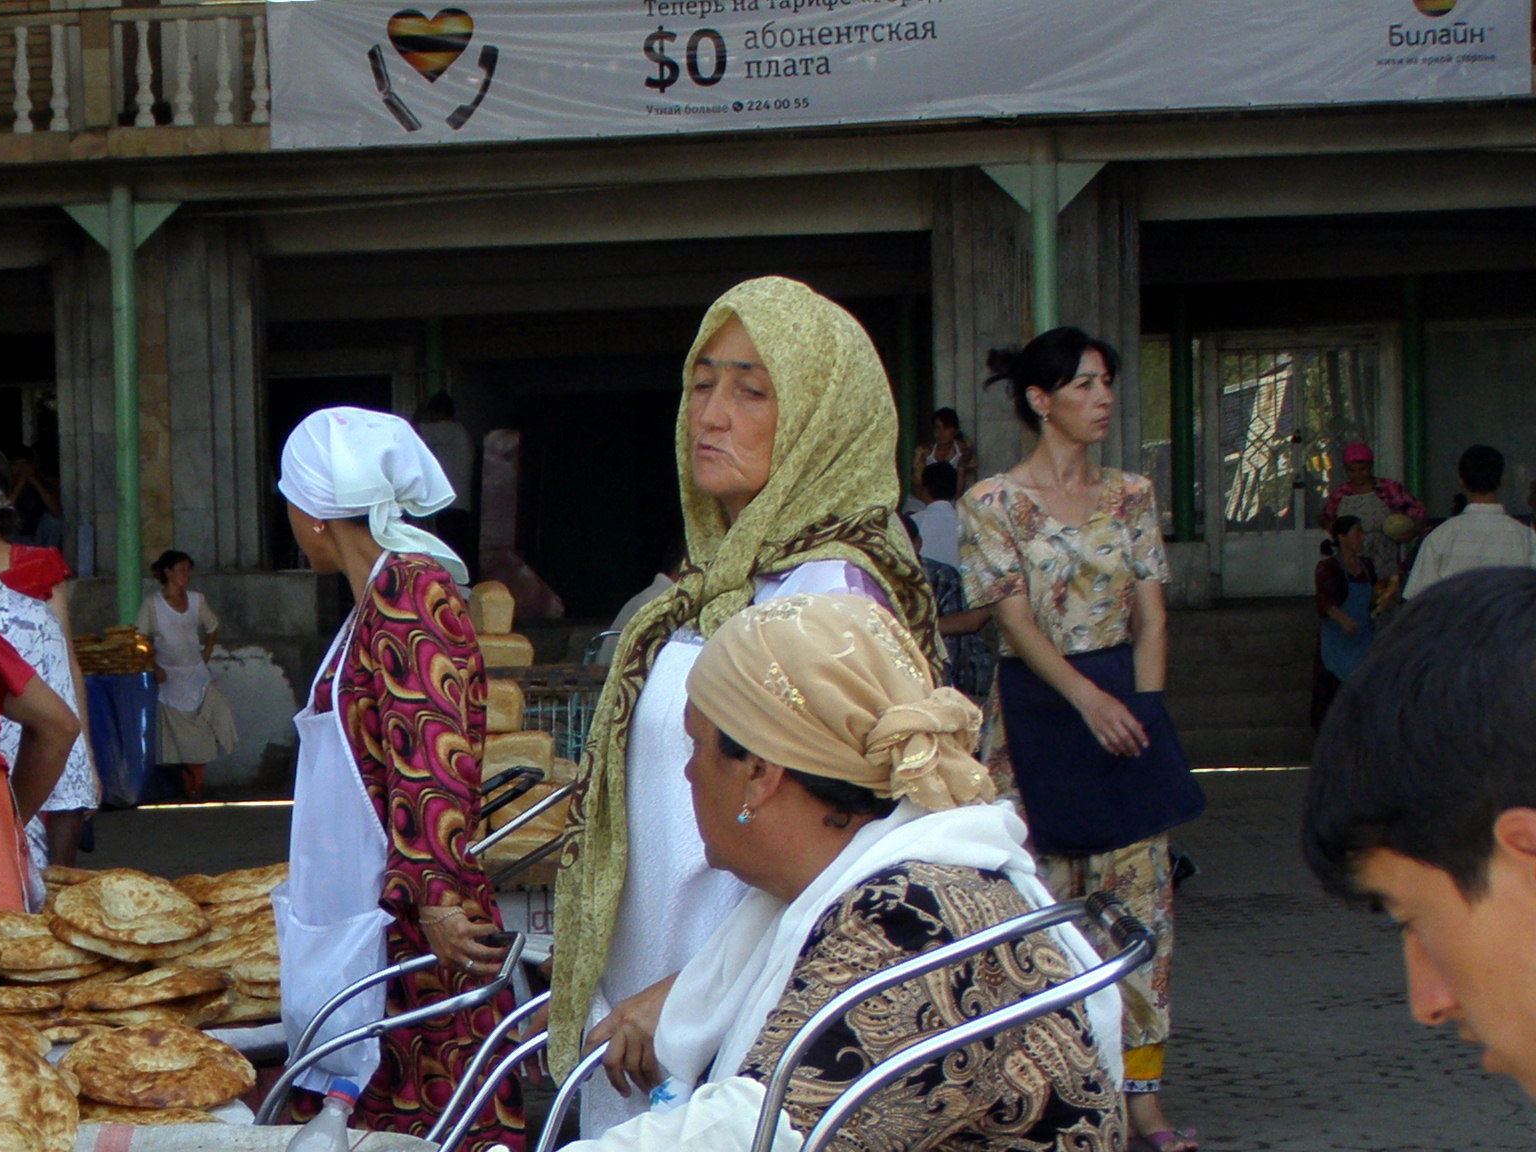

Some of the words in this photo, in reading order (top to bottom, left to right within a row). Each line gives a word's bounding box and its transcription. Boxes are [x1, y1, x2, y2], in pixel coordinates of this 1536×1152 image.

[744, 19, 938, 50] абонентская
[1388, 21, 1484, 47] Билайн
[643, 24, 727, 93] $0
[744, 55, 832, 79] плата
[684, 103, 728, 115] больше
[747, 100, 770, 111] 224
[774, 98, 790, 110] 00
[794, 97, 810, 109] 55
